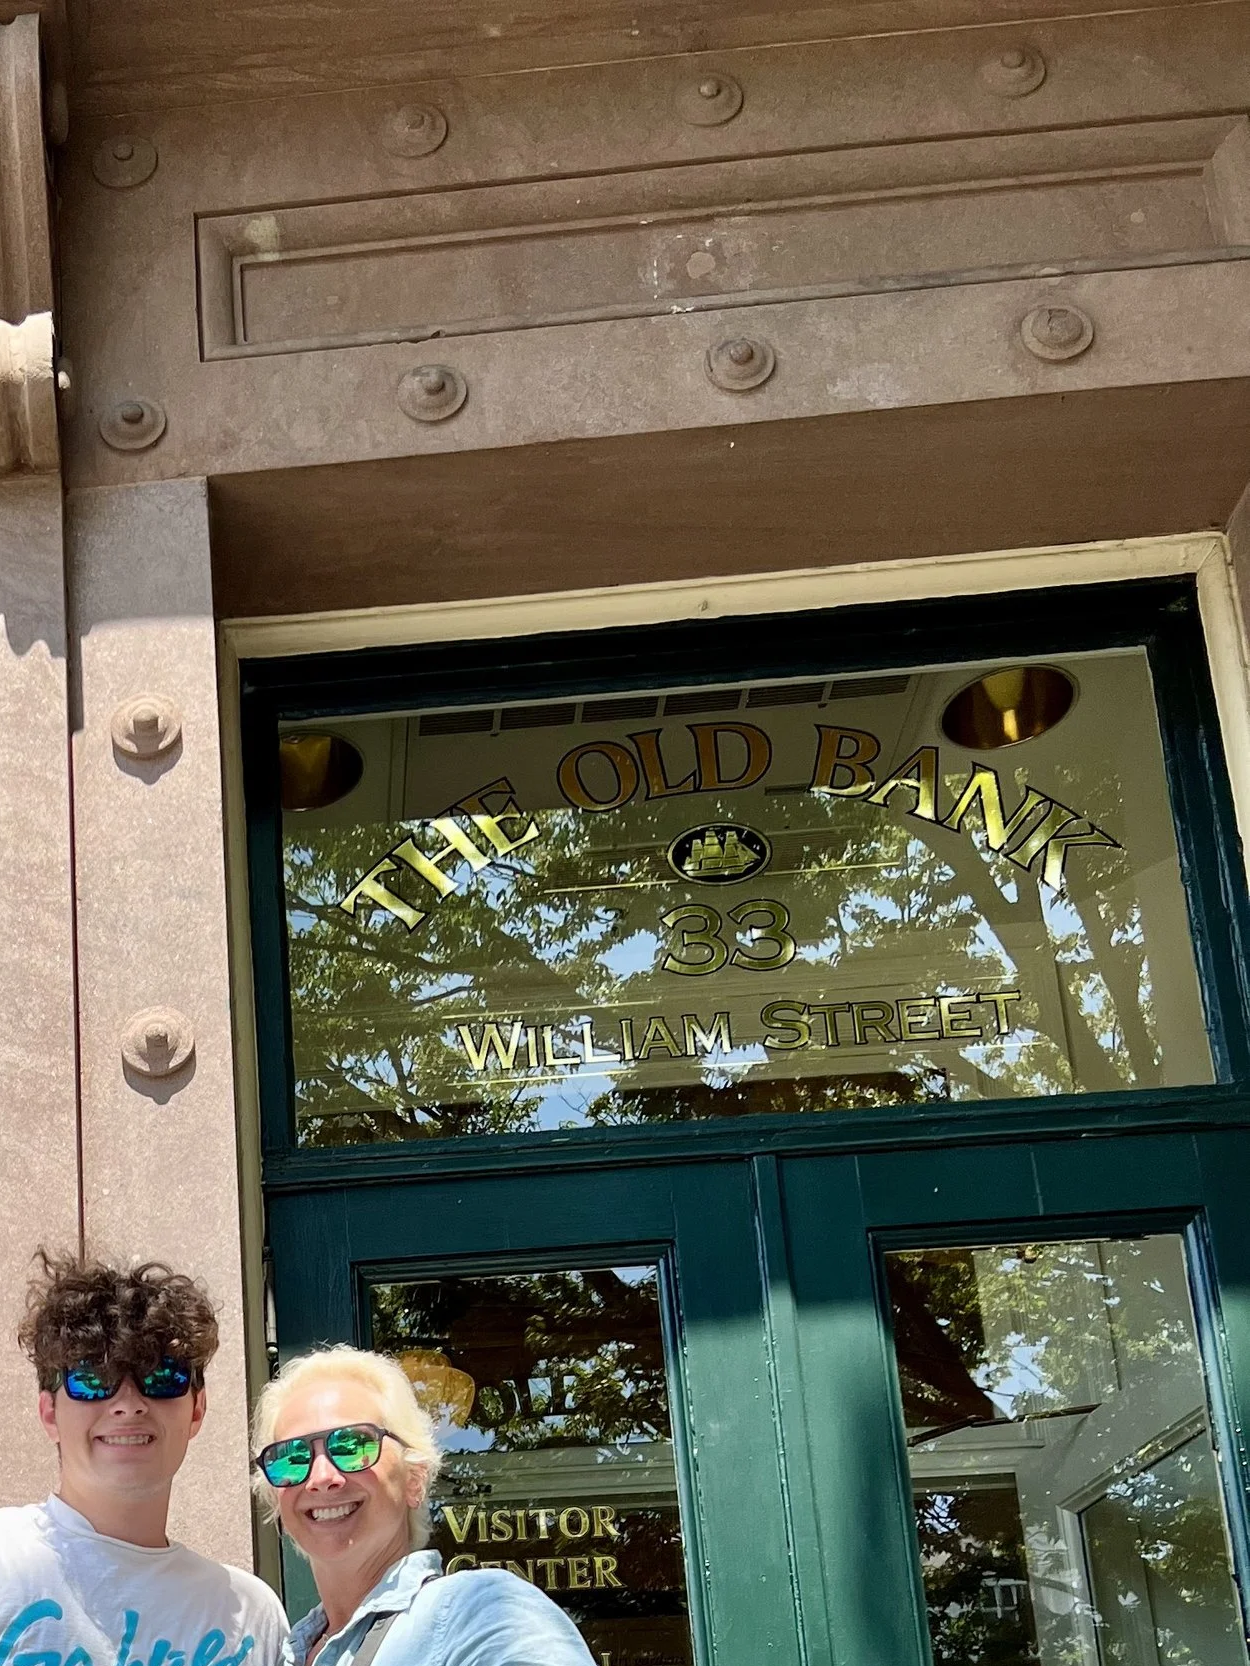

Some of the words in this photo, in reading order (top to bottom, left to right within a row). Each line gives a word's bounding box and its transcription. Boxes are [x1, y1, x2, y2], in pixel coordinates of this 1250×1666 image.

[339, 777, 541, 932] THE
[557, 721, 771, 813] OLD
[810, 723, 1123, 893] BANK
[660, 899, 796, 976] 33
[458, 1009, 731, 1072] WILLIAM
[760, 990, 1021, 1051] STREET
[440, 1504, 622, 1544] VISITOR
[445, 1553, 628, 1590] CNTER
